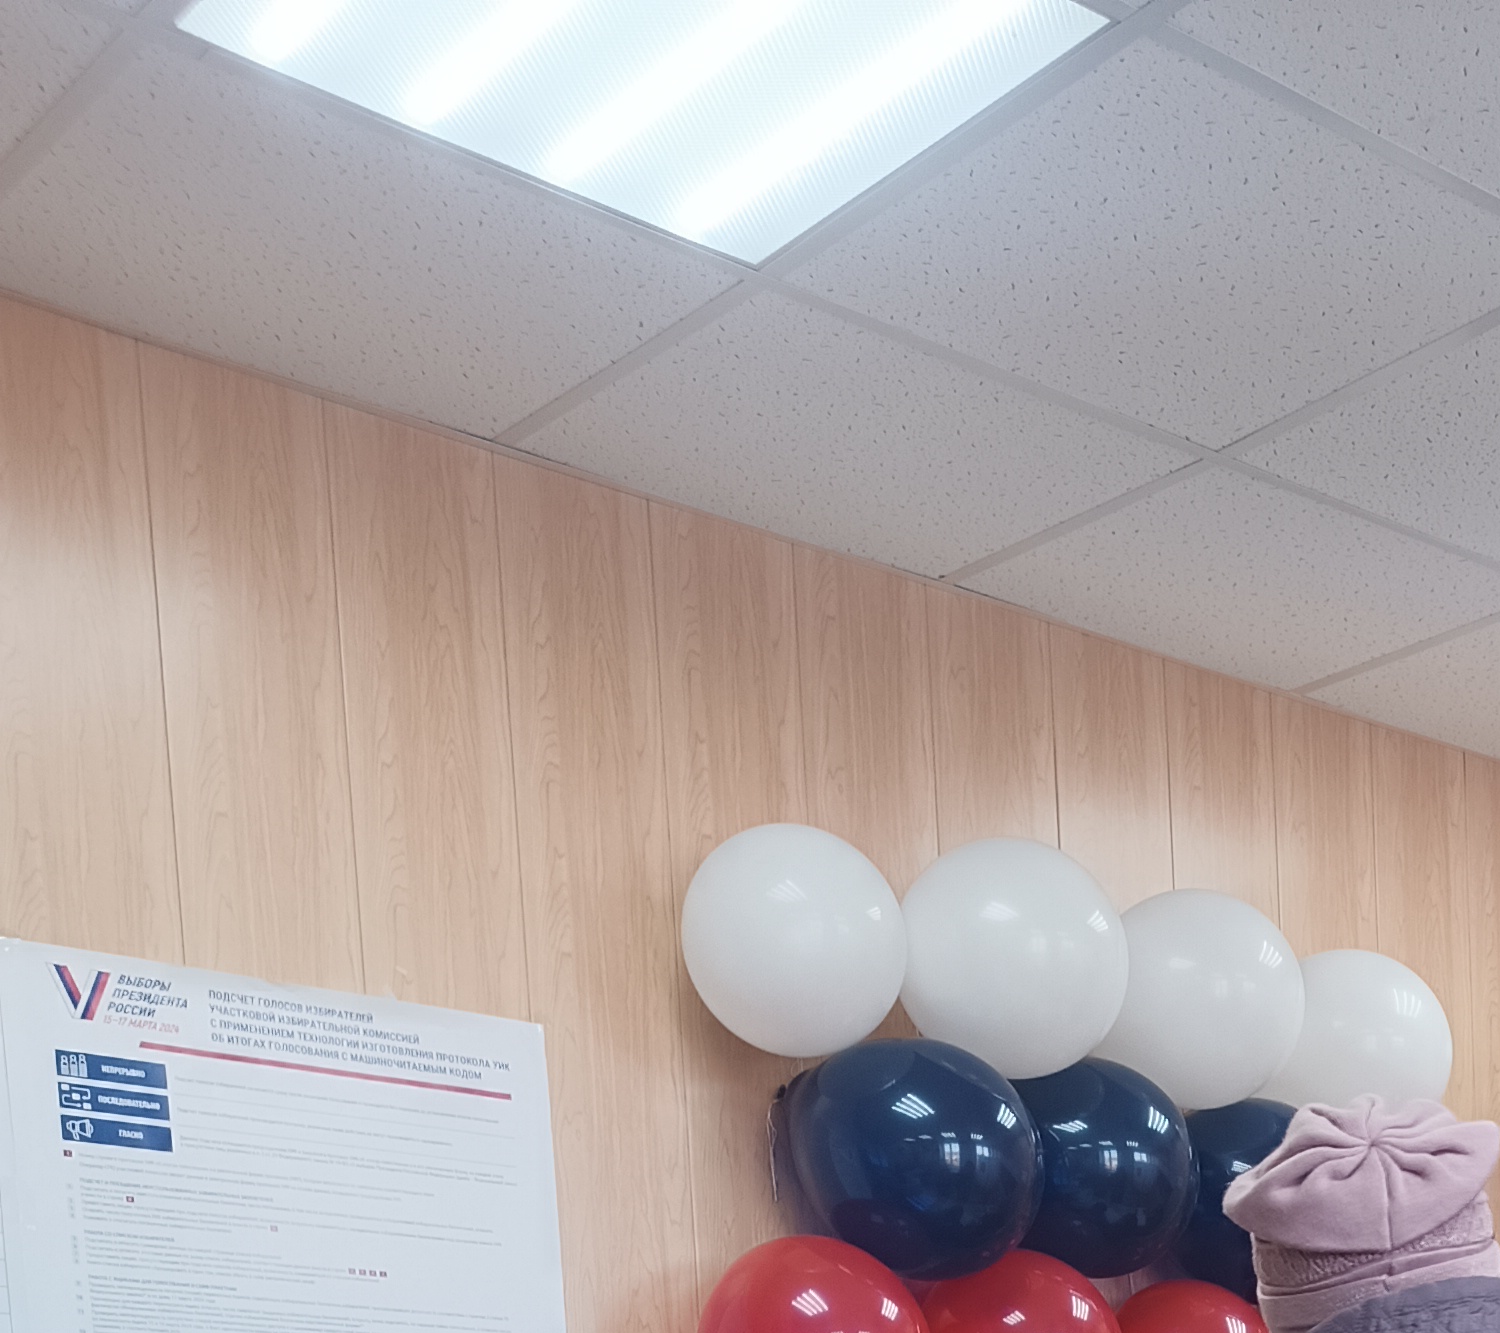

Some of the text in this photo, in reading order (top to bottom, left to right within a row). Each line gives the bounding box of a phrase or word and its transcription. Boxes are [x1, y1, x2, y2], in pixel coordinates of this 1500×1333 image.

[117, 974, 171, 992] ВЫБОРЫ
[107, 1001, 156, 1018] РОССИИ
[112, 988, 188, 1009] ПРЕЗИДЕНТА
[208, 989, 373, 1024] ПОДСЧЕТ ГОЛОСОВ ИЗБИРАТЕЛЕЙ
[128, 1019, 157, 1031] МАРТА
[158, 1023, 181, 1034] 2024
[209, 1003, 420, 1045] УЧАСТКОВОЙ ИЗБИРАТЕЛЬНОЙ КОМИССИЕЙ
[210, 1019, 511, 1072] С ПРИМЕНЕНИЕМ ТЕХНОЛОГИИ ИЗГОТОВЛЕНИЯ ПРОТОКОЛА УИК
[211, 1033, 482, 1081] ОБ ИТОГАХ ГОЛОСОВАНИЯ С МАШИНОЧИТАЕМЫМ КОДОМ
